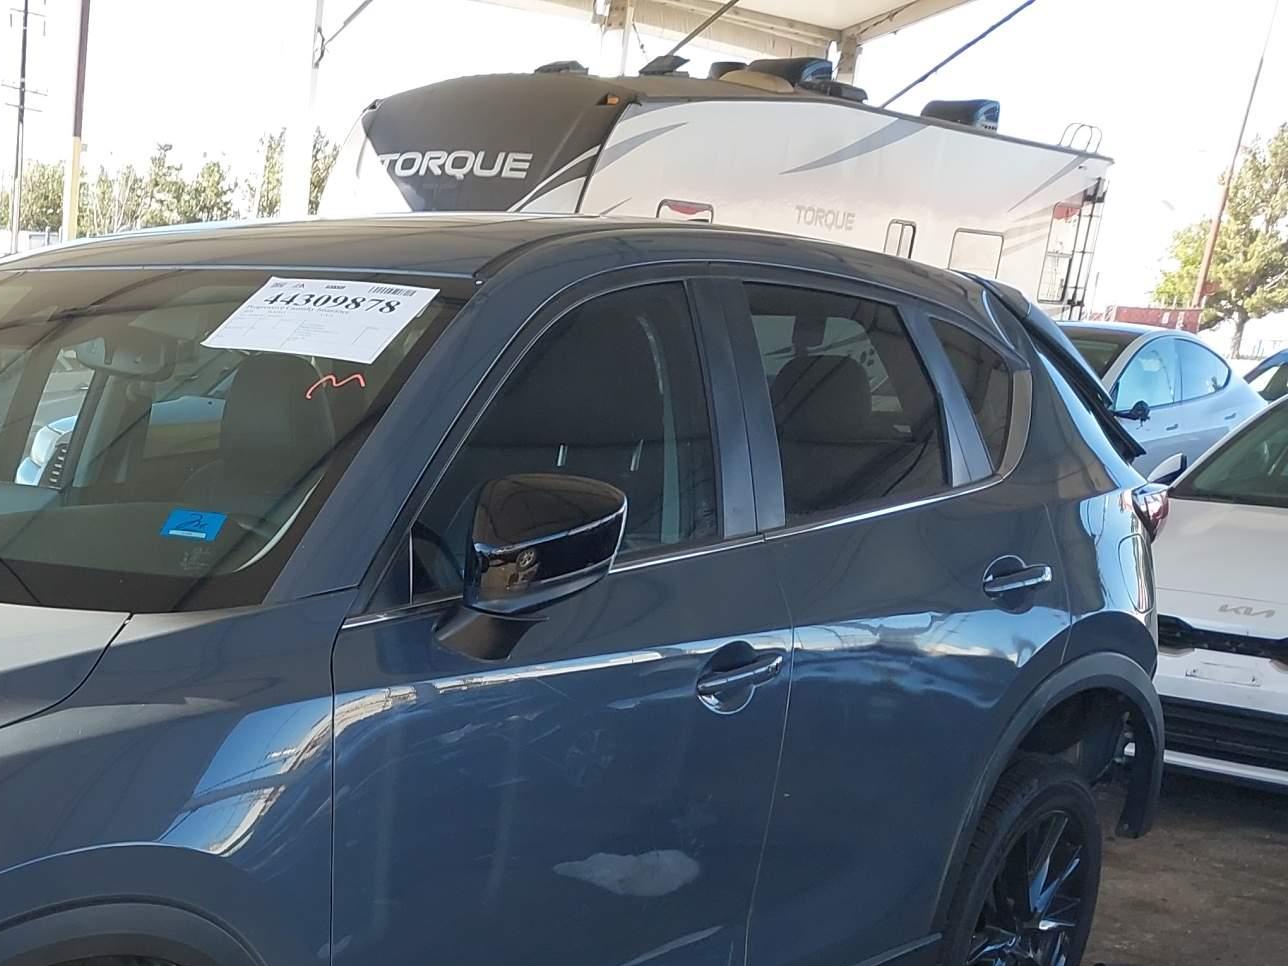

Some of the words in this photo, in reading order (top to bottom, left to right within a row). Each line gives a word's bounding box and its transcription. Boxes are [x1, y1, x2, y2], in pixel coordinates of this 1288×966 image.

[378, 149, 534, 180] TORQUE
[795, 204, 856, 231] TORQUE
[263, 292, 401, 314] 44309878
